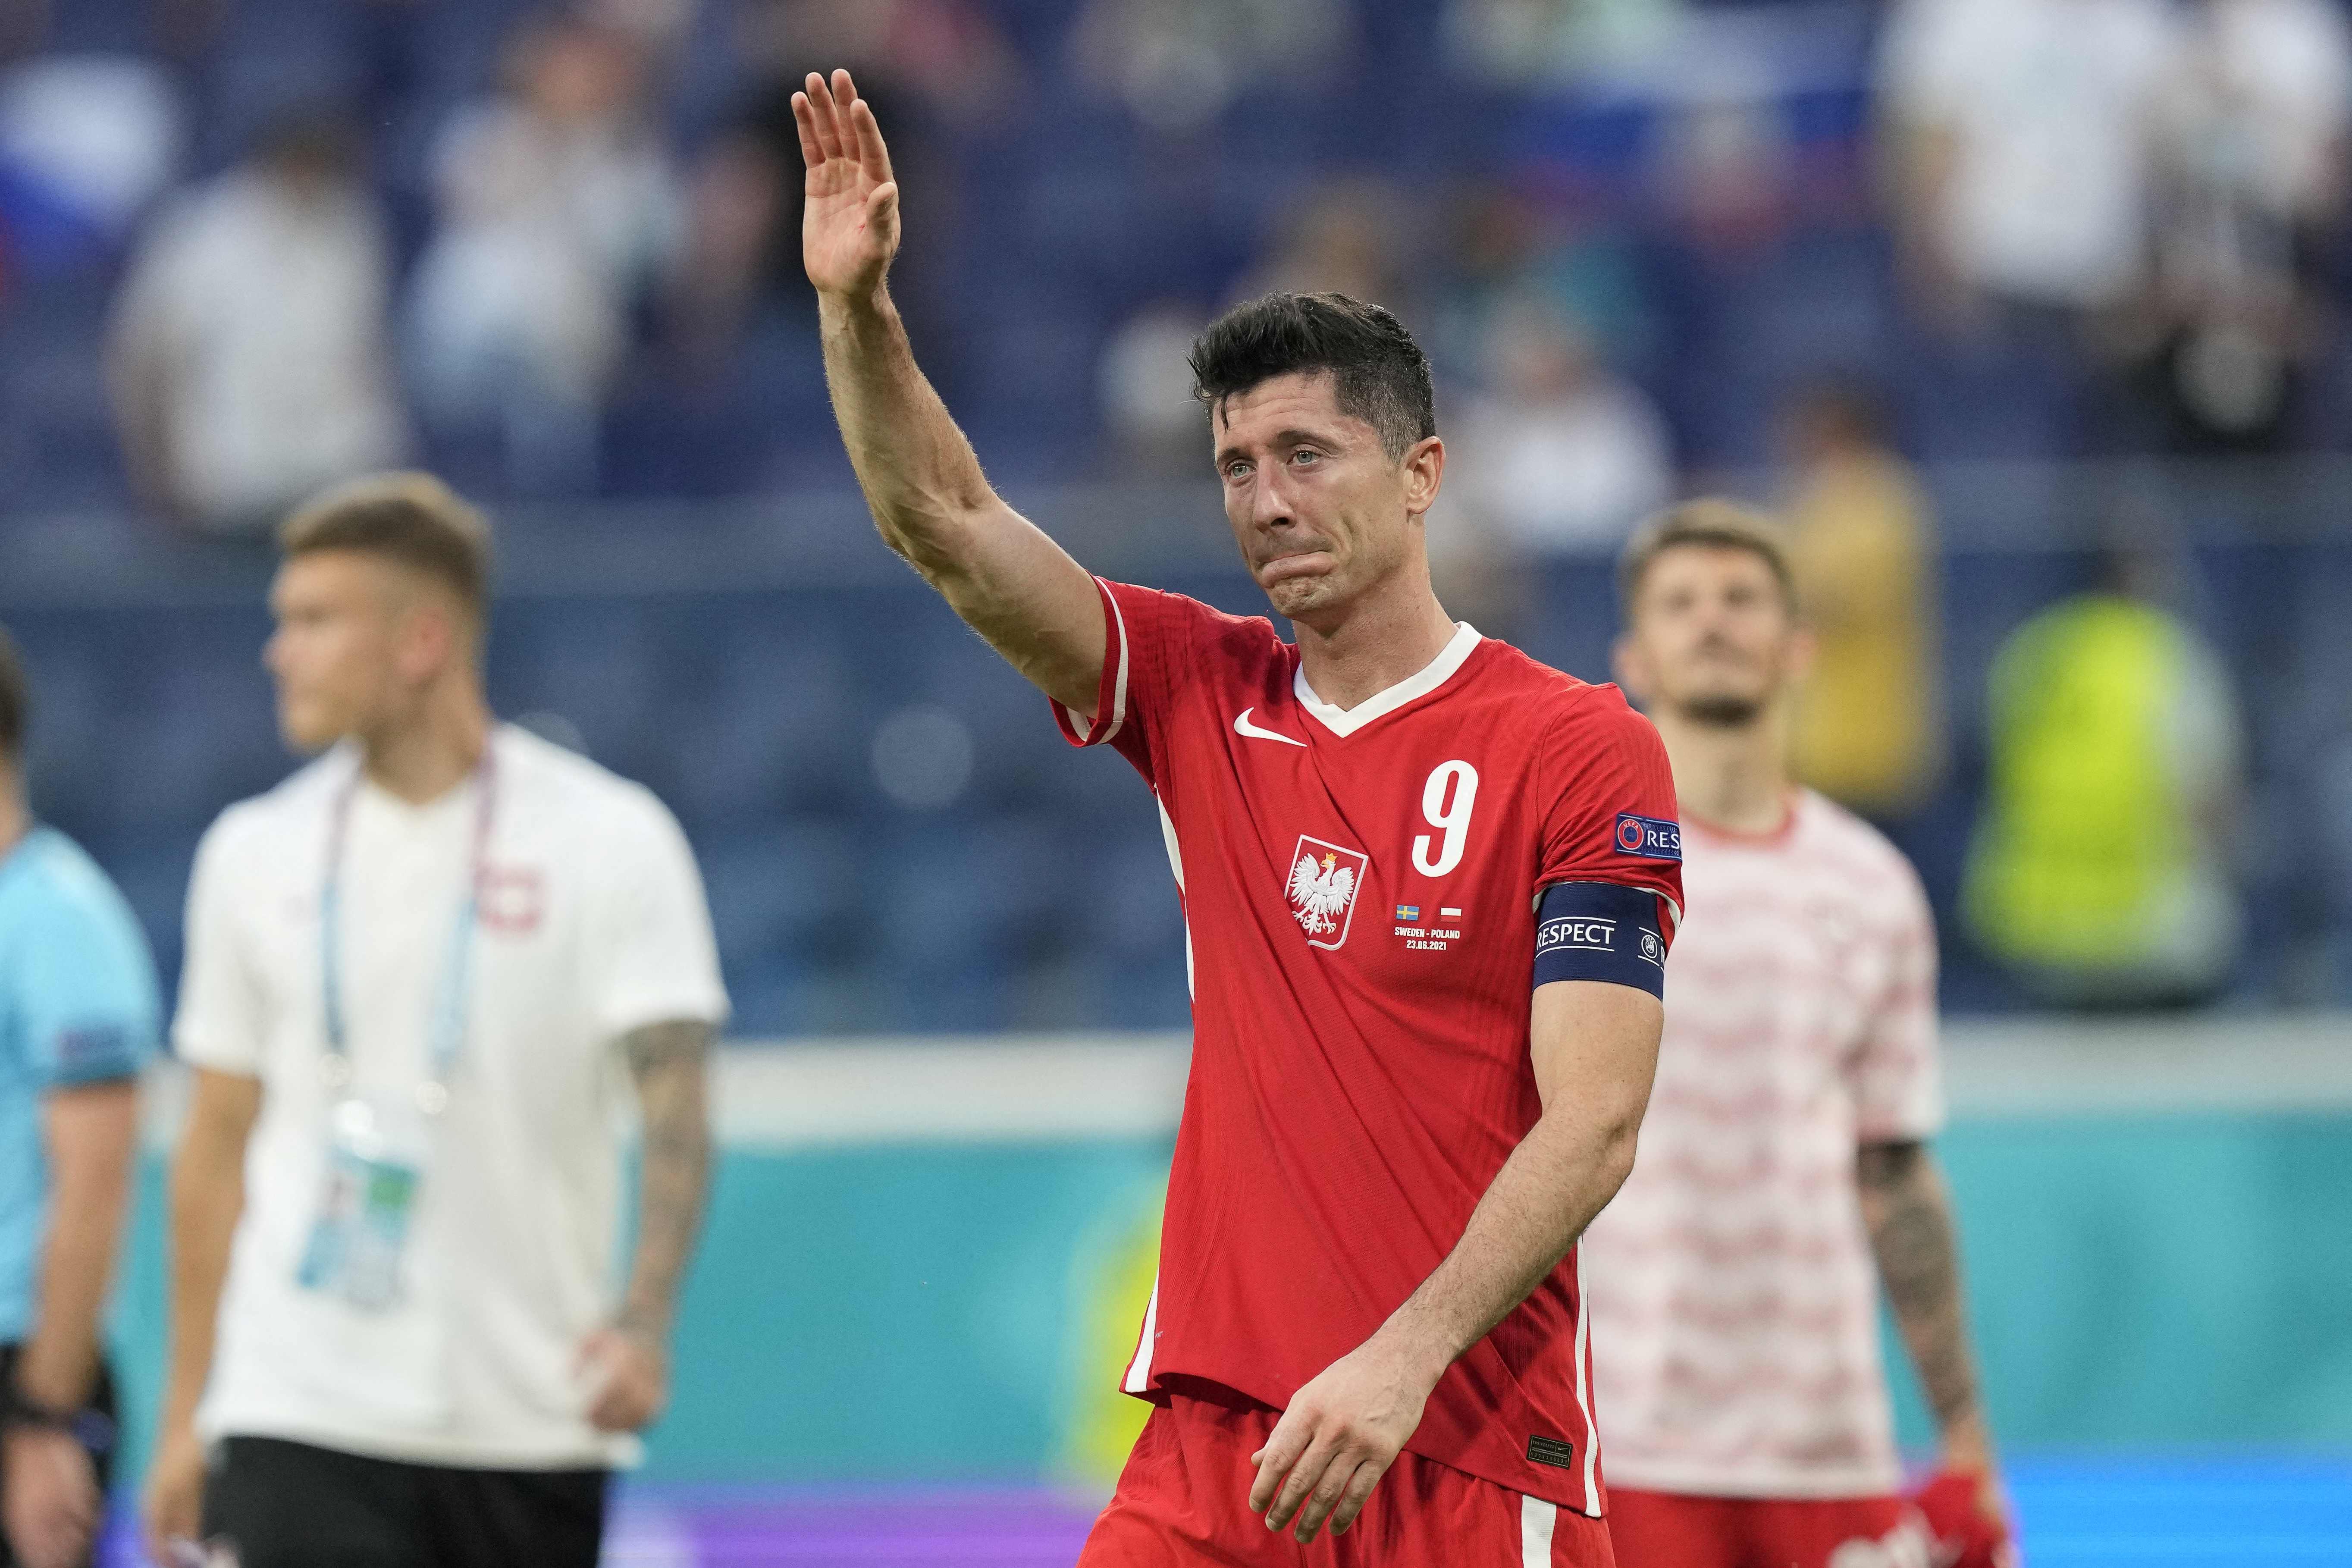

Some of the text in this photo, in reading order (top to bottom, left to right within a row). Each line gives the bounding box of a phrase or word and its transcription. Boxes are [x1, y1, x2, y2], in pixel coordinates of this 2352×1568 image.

[1412, 759, 1479, 877] 9
[1623, 820, 1639, 829] UEFA
[1394, 926, 1425, 938] SWEDEN
[1431, 929, 1460, 939] POLAND
[1537, 924, 1615, 951] RESPECT
[1406, 940, 1447, 950] 23.06.2021
